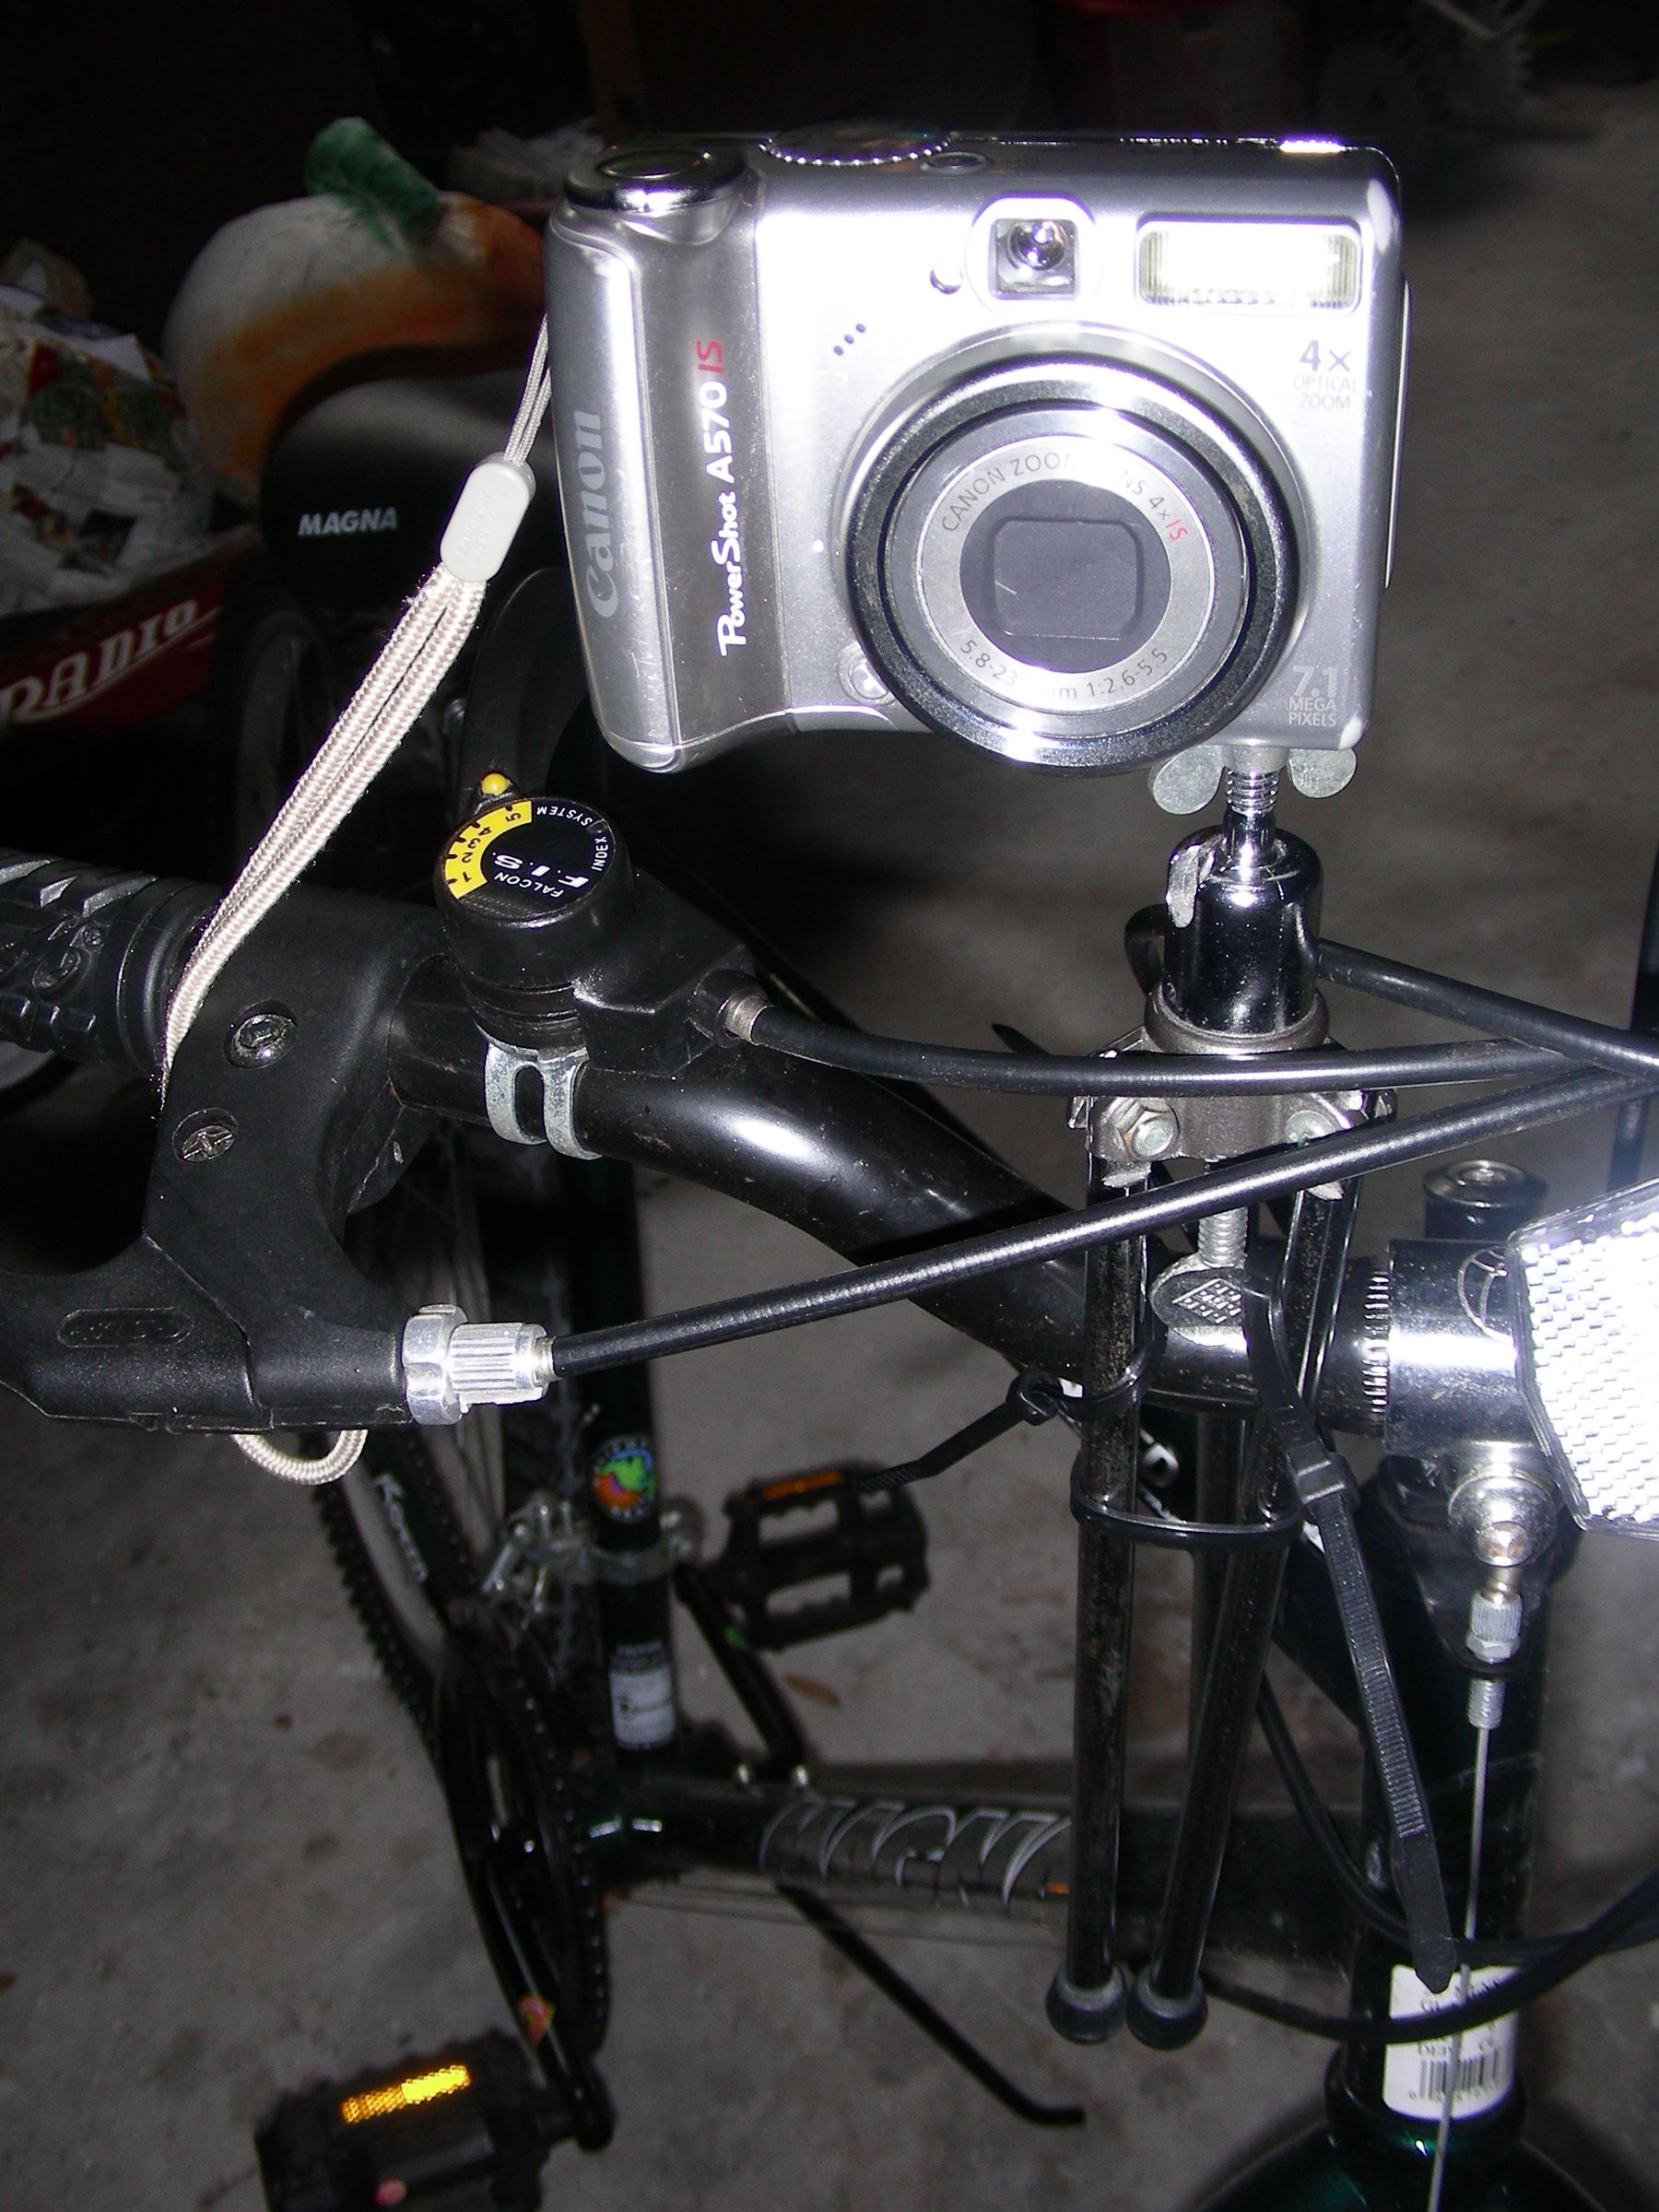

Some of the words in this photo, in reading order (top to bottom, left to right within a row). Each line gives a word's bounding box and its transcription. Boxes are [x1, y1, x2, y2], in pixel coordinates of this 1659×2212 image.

[696, 337, 724, 373] IS
[1292, 373, 1358, 393] OPTICAL
[1299, 392, 1351, 411] ZOOM
[698, 380, 735, 484] A570
[573, 409, 618, 618] Canon
[941, 466, 1006, 533] CANON
[297, 507, 398, 537] MAGNA
[711, 490, 747, 657] PowerShot
[0, 599, 199, 724] RADIO
[1087, 647, 1169, 698] 1:2.6-5.5
[1292, 665, 1337, 699] 7.1
[1288, 696, 1337, 712] MEGA
[1288, 711, 1337, 728] PIXELS
[477, 825, 492, 837] 4
[504, 811, 522, 823] 5
[536, 806, 593, 827] SYSTEM
[461, 851, 472, 864] 2
[466, 837, 481, 850] 3
[590, 835, 609, 872] INDEX
[462, 871, 472, 884] 1
[493, 870, 565, 899] FALCON
